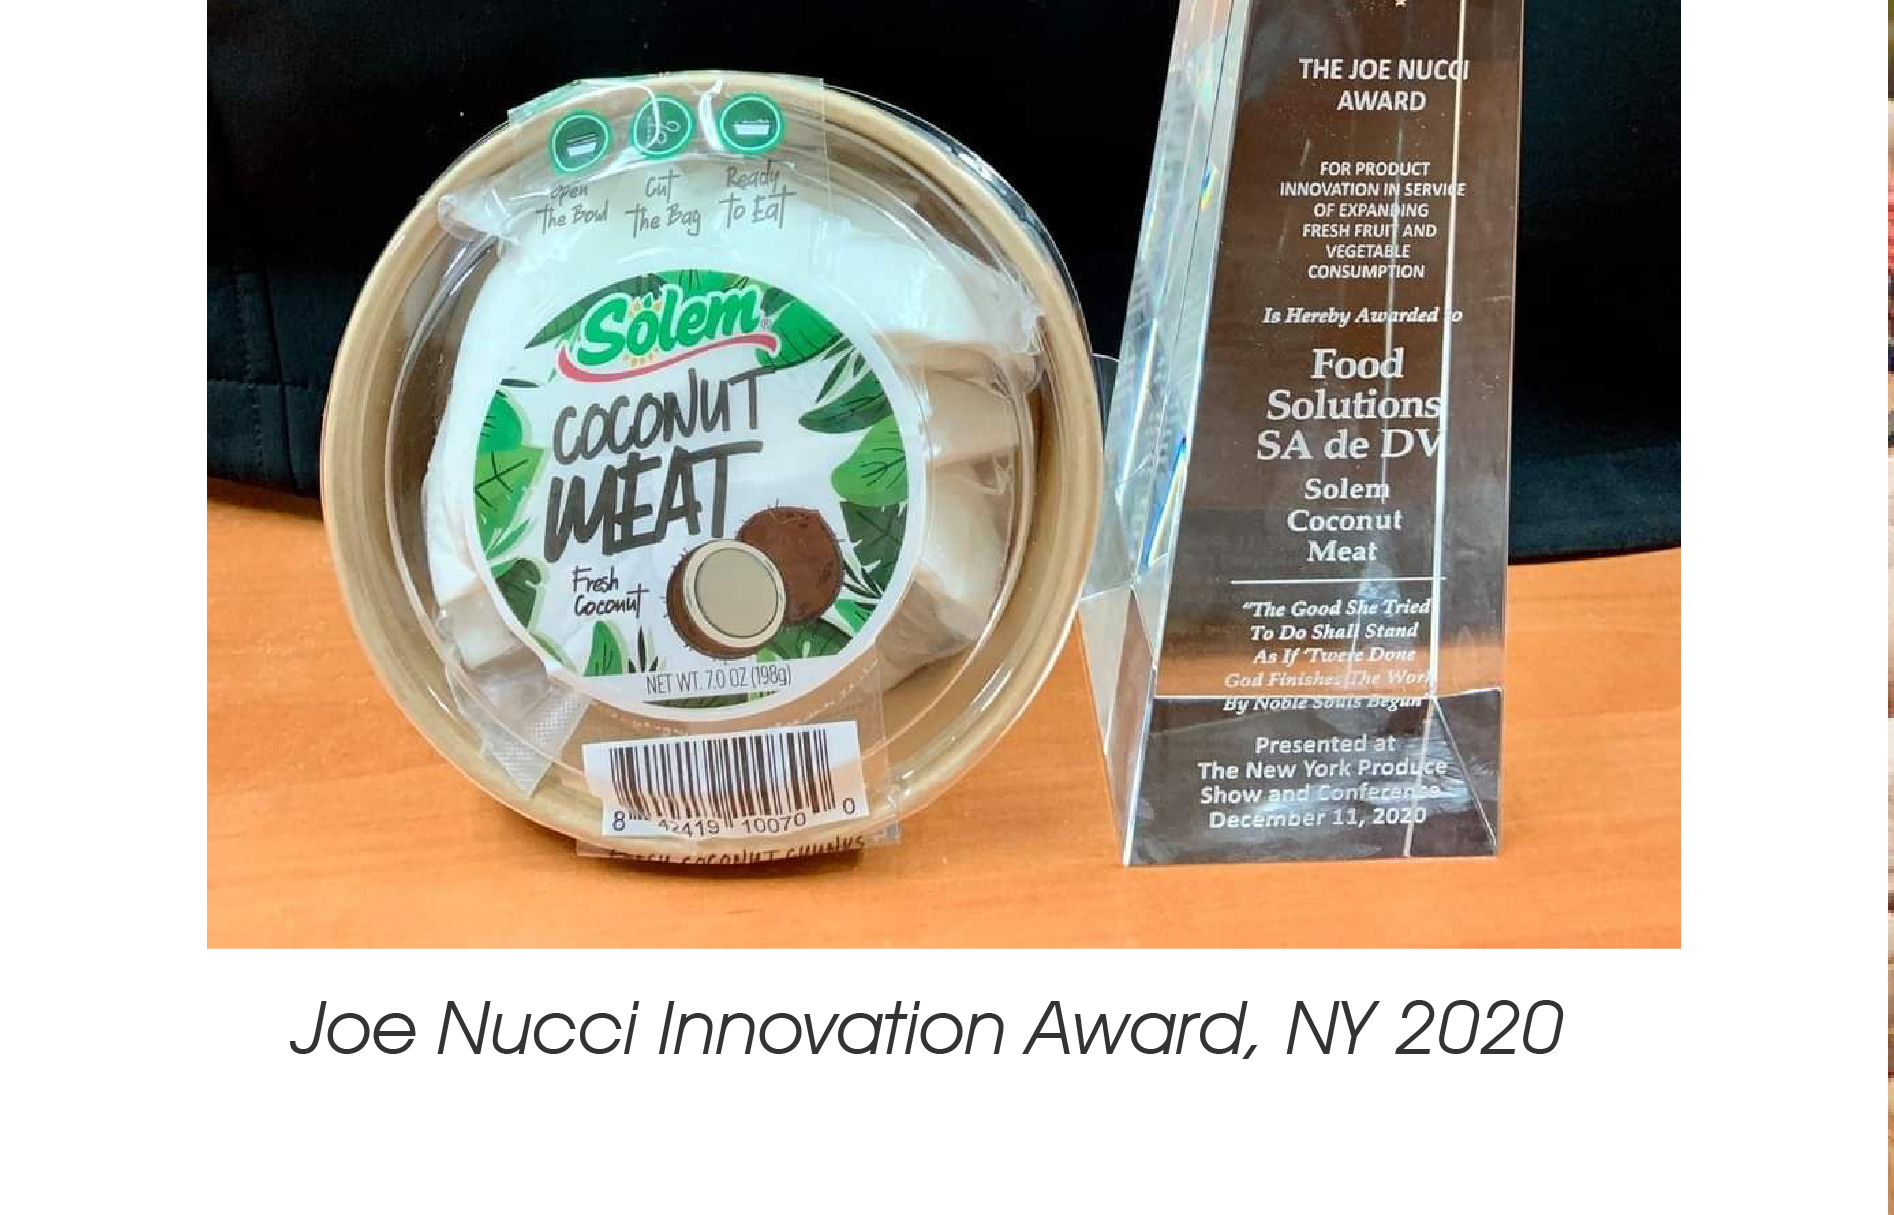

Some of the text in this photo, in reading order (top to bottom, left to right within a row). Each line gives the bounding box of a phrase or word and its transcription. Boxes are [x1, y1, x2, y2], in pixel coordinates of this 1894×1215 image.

[1299, 59, 1470, 80] THE JOE NUCCI
[1337, 90, 1427, 111] AWARD
[726, 160, 780, 192] Ready
[1320, 162, 1430, 176] FOR PRODUCT
[644, 168, 681, 203] Cut
[1280, 182, 1466, 196] INNOVATION IN SERVICE
[572, 200, 608, 223] Bowl
[752, 186, 798, 229] Eat
[1314, 203, 1429, 217] OF EXPANDING
[666, 203, 701, 236] Bag
[1303, 224, 1437, 237] FRESH FRUIT AND
[1326, 244, 1411, 259] VEGETABLE
[1308, 265, 1425, 278] CONSUMPTION
[1262, 307, 1281, 323] Is
[1284, 307, 1351, 327] Hereby
[1355, 307, 1440, 323] Awarded
[1310, 347, 1404, 379] Food
[1266, 388, 1442, 420] Solutions
[554, 367, 776, 465] COCONUT
[1257, 429, 1313, 460] SA
[1324, 429, 1370, 460] de
[1305, 478, 1390, 499] Solem
[544, 440, 763, 563] MEAT
[1287, 509, 1403, 531] Coconut
[1306, 540, 1378, 562] Meat
[573, 566, 619, 592] Fresh
[574, 583, 649, 618] Coconut
[1291, 600, 1340, 617] Good
[1345, 600, 1376, 615] She
[1383, 598, 1431, 614] Tried
[1250, 622, 1419, 640] To Do Shall Stand
[1253, 650, 1277, 664] As
[1283, 648, 1300, 667] If
[1369, 647, 1416, 662] Done
[647, 674, 673, 694] NET
[677, 672, 703, 691] WT.
[730, 668, 747, 687] OZ
[752, 665, 792, 687] (198g)
[1225, 673, 1263, 688] God
[1255, 734, 1397, 754] Presented at
[1198, 759, 1447, 780] The New York Produce
[1200, 782, 1441, 804] Show and Conference
[612, 810, 626, 831] 8
[741, 811, 806, 834] 10070
[842, 798, 856, 816] 0
[1209, 808, 1427, 829] December 11, 2020
